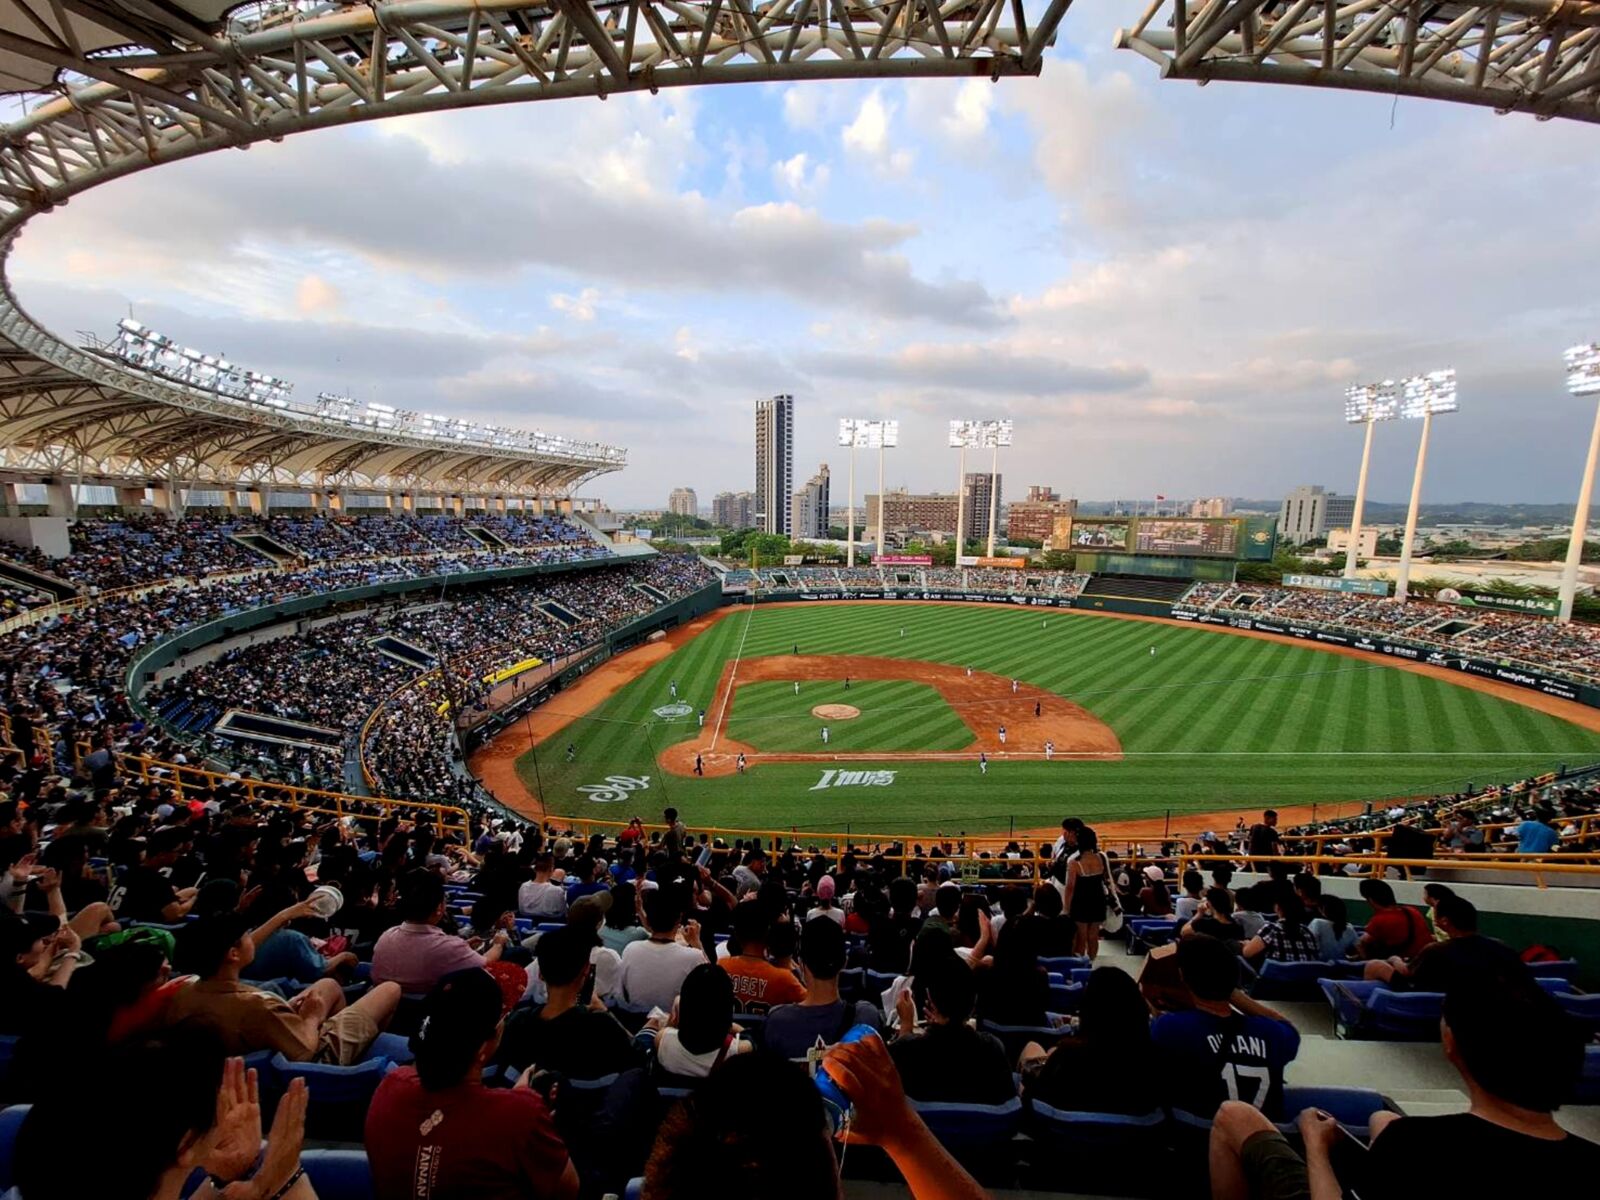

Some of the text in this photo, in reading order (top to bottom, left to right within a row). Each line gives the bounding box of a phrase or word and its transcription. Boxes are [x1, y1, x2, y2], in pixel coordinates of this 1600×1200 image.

[1289, 626, 1312, 635] SONY
[1496, 668, 1536, 685] FamilyMart
[729, 973, 768, 998] OSEY
[1207, 1034, 1266, 1059] OANI
[1221, 1062, 1270, 1109] 17
[417, 1145, 433, 1197] TAINAN
